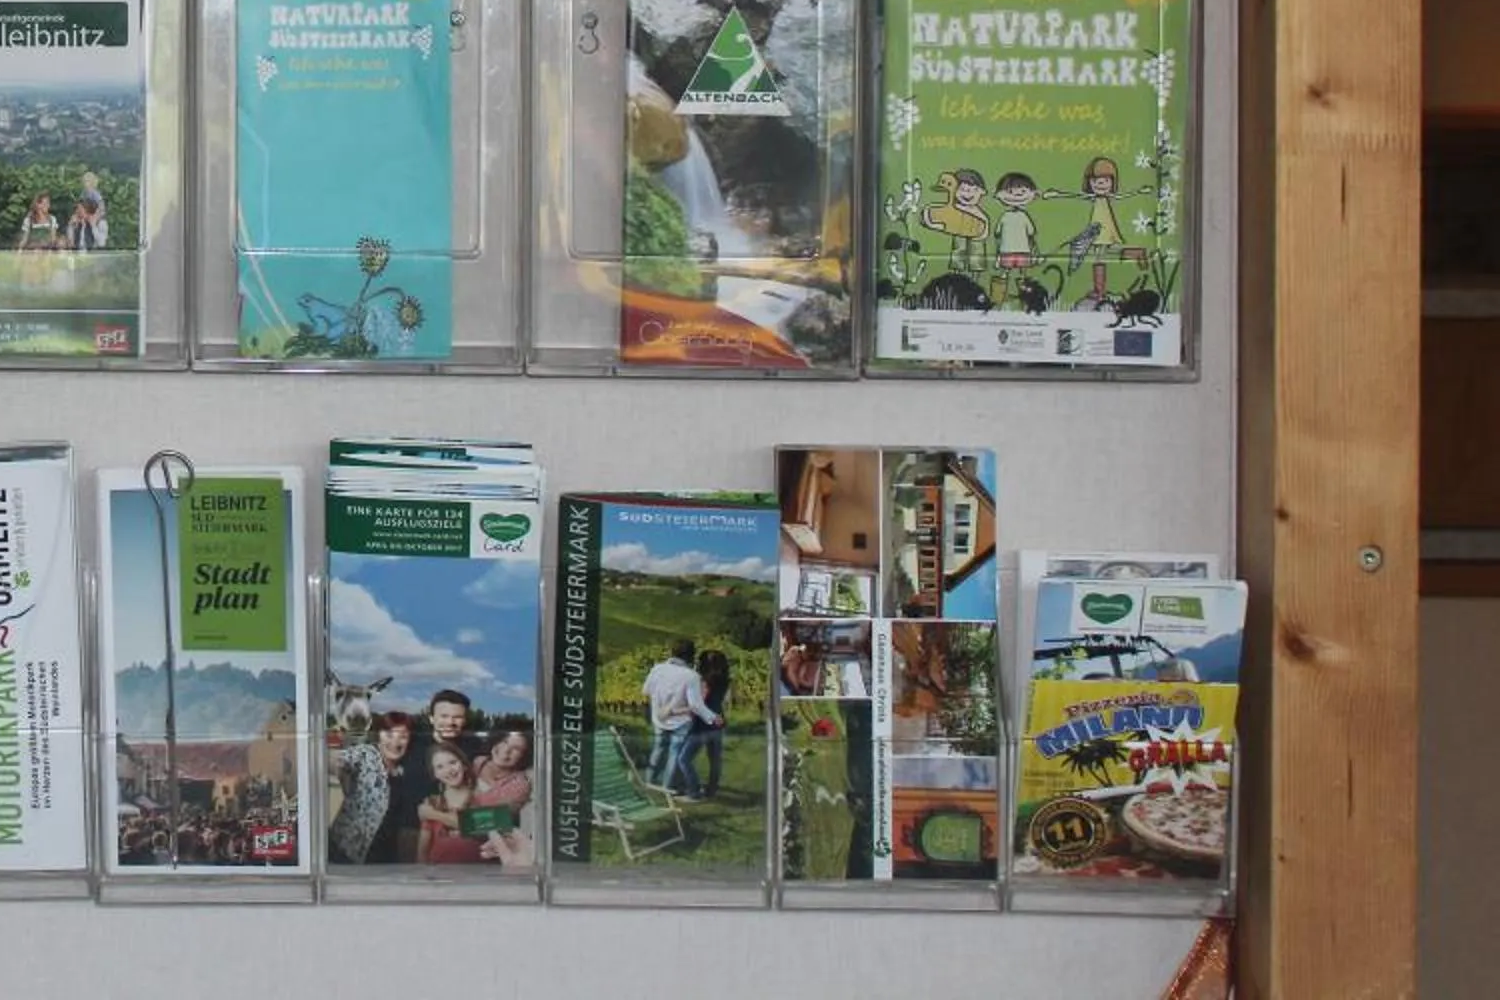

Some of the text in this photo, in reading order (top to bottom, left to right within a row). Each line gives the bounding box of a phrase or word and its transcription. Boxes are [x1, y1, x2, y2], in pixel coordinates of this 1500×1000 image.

[270, 1, 410, 26] NATURPARK
[0, 24, 105, 48] leibnitz
[912, 9, 1138, 49] NATURPARK
[910, 51, 1137, 86] SÜDSTEIERMARK
[682, 91, 783, 104] ALTENBACH
[941, 95, 978, 119] Ich
[990, 96, 1050, 120] sehe
[190, 495, 268, 511] LEIBNITZ
[347, 505, 440, 519] EINE KARTE FÜR
[374, 518, 463, 529] AUSFLUGSZIELE
[483, 538, 525, 553] Card
[194, 562, 272, 585] Stadt
[193, 586, 260, 616] plan
[564, 503, 590, 690] SÜDSTEIERMARK
